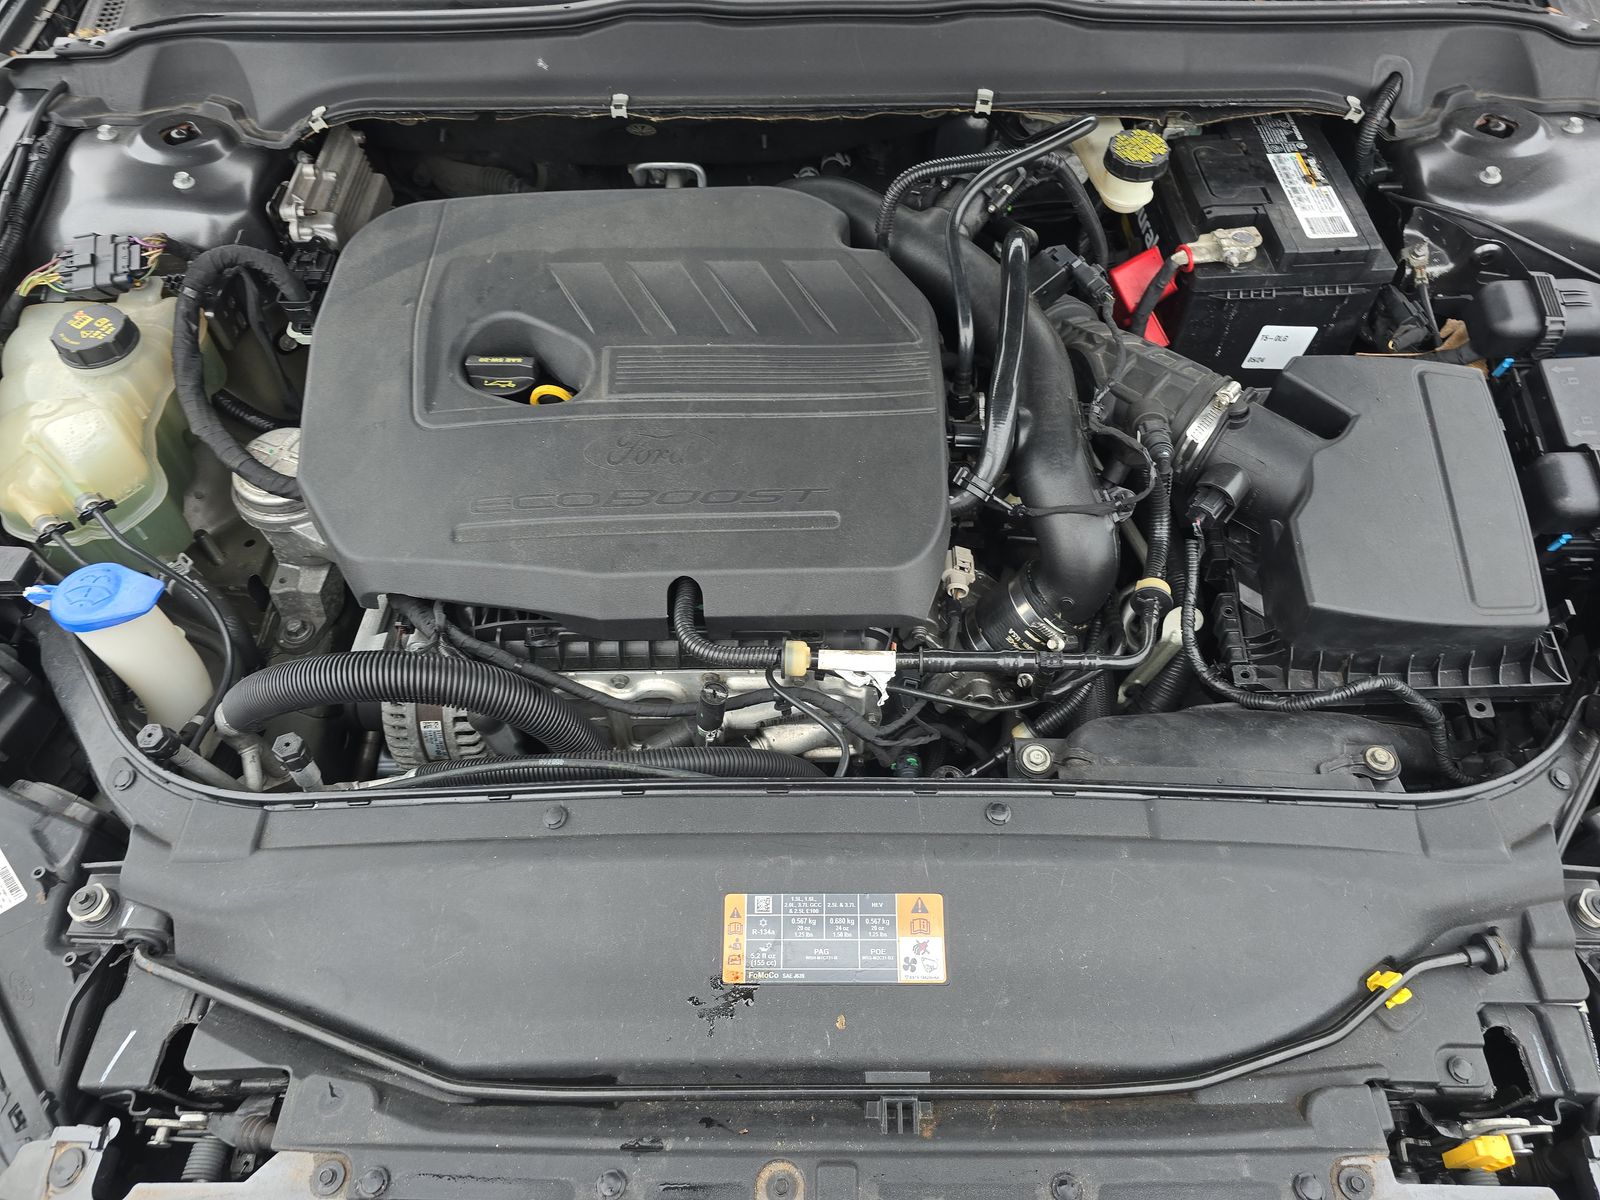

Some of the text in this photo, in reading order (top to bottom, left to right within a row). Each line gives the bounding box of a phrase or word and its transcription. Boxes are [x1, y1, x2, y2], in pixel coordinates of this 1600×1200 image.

[1136, 206, 1160, 250] ural
[606, 433, 695, 467] Ford
[808, 917, 817, 925] kg
[846, 917, 855, 925] kg
[881, 917, 890, 925] kg
